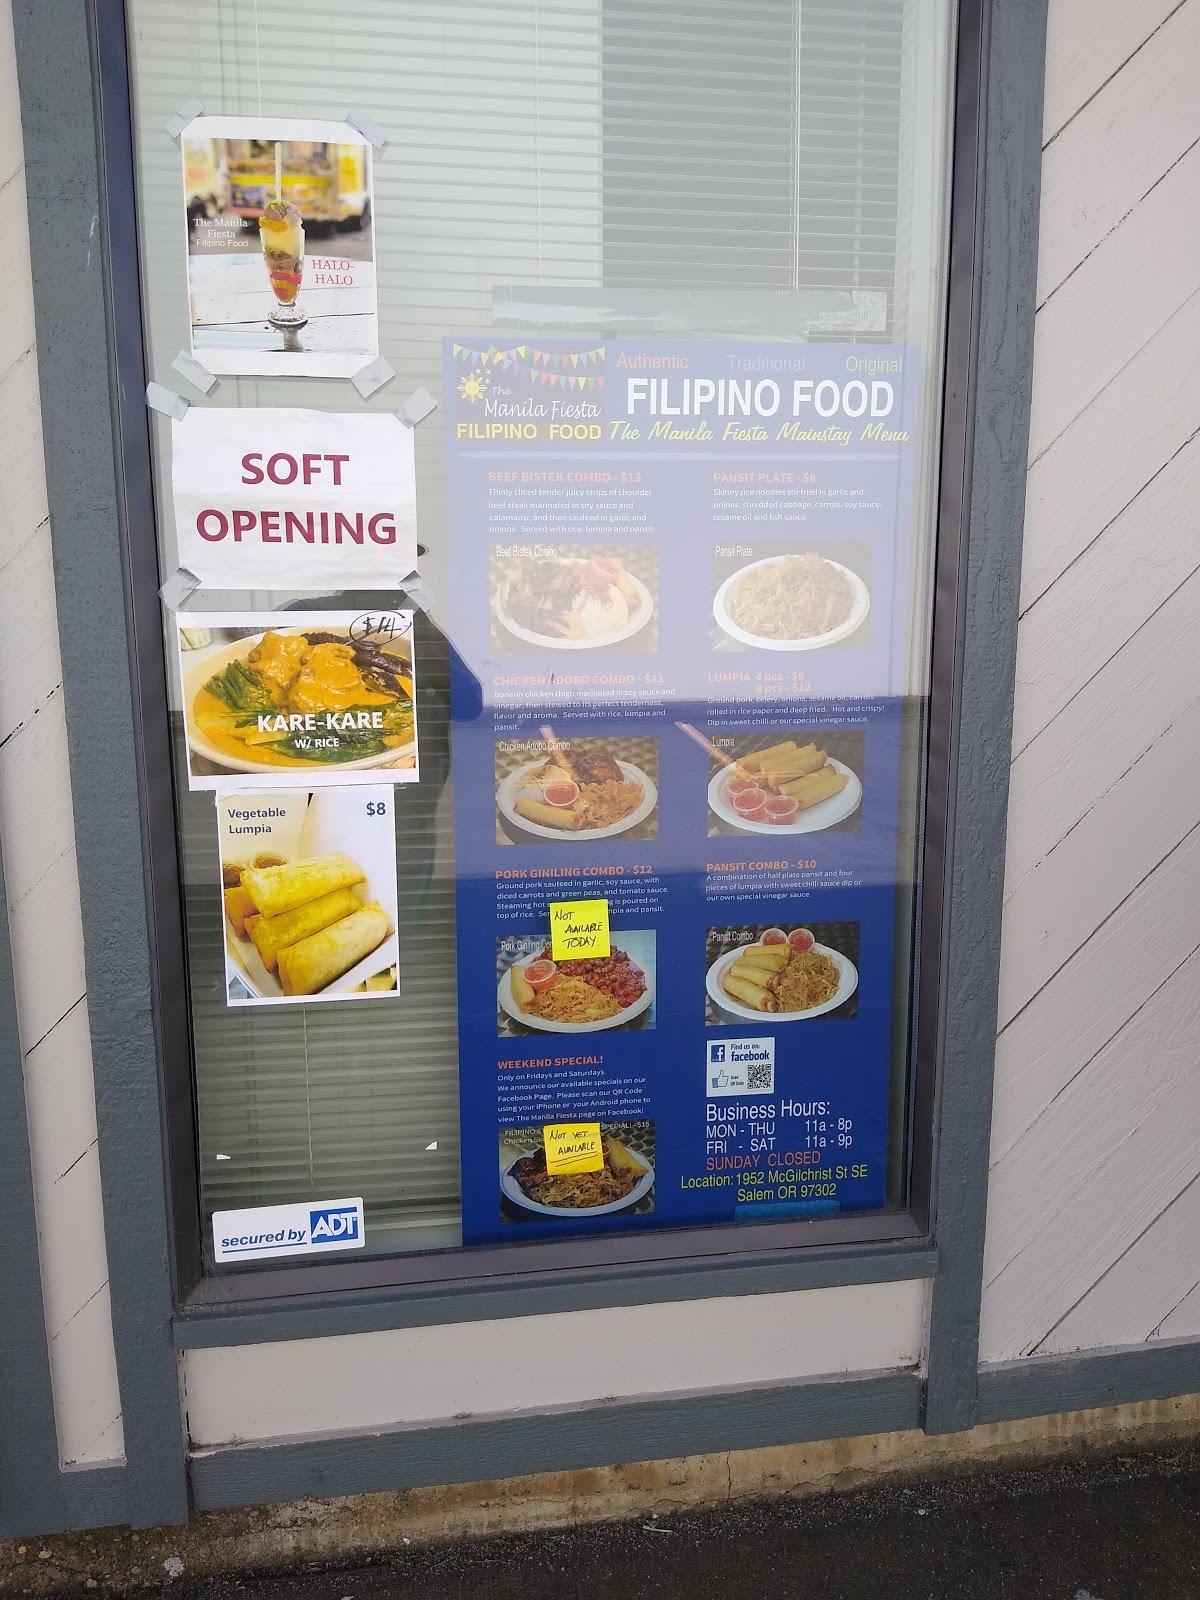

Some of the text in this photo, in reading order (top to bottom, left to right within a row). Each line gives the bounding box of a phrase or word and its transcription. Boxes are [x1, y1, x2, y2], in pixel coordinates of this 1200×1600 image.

[195, 218, 248, 228] The Manila
[208, 229, 236, 238] Fiesta
[197, 239, 249, 248] Filipino Food
[312, 260, 355, 270] HALO-
[316, 275, 353, 286] HALO
[616, 352, 902, 375] Authentic Traditional Original
[627, 377, 895, 418] FILIPINO FOOD
[484, 396, 602, 420] Manila Fiesta
[457, 423, 602, 440] FILIPINO FOOD
[609, 420, 910, 446] The Manila Fiesta Mainstay Menu
[241, 452, 350, 486] SOFT
[488, 472, 518, 482] BEEF
[521, 472, 565, 482] BISTEK
[567, 472, 611, 482] COMBO
[713, 472, 795, 482] PANSIT PLATE
[488, 488, 512, 498] Thinly
[196, 508, 397, 545] OPENING
[494, 674, 635, 686] CHICKEN COMBO
[708, 673, 751, 682] LUMPIA
[257, 711, 384, 734] KARE-KARE
[708, 719, 720, 728] Dip
[793, 717, 818, 726] special
[819, 716, 846, 725] vinegar
[295, 738, 340, 749] W/ RICE
[228, 808, 286, 820] Vegetable
[366, 801, 386, 818] $8
[229, 824, 272, 836] Lumpia
[495, 864, 653, 879] PORK GINILING COMBO $12
[706, 860, 816, 872] PANSIT COMBO $10
[526, 881, 542, 890] pork
[736, 893, 761, 902] special
[762, 892, 788, 901] vinegar
[554, 910, 575, 921] NOT
[501, 940, 517, 951] Pork
[731, 1050, 770, 1062] facebook
[498, 1056, 604, 1070] WEEKEND SPECIAL!
[498, 1074, 514, 1082] Only
[526, 1072, 552, 1081] Fridays
[594, 1078, 622, 1087] specials
[498, 1094, 532, 1102] Facebook
[498, 1104, 518, 1114] using
[620, 1098, 642, 1107] phone
[706, 1099, 830, 1122] Business Hours:
[504, 1128, 536, 1137] FILIPINO
[706, 1118, 852, 1138] MON THU 11a 8p
[706, 1134, 853, 1154] FRI SAT 11a 9p
[706, 1151, 821, 1171] SUNDAY CLOSED
[680, 1164, 868, 1190] Location: 1952 McGilchrist St SE
[737, 1182, 836, 1202] Salem OR 97302
[221, 1213, 355, 1248] secured by ADT
